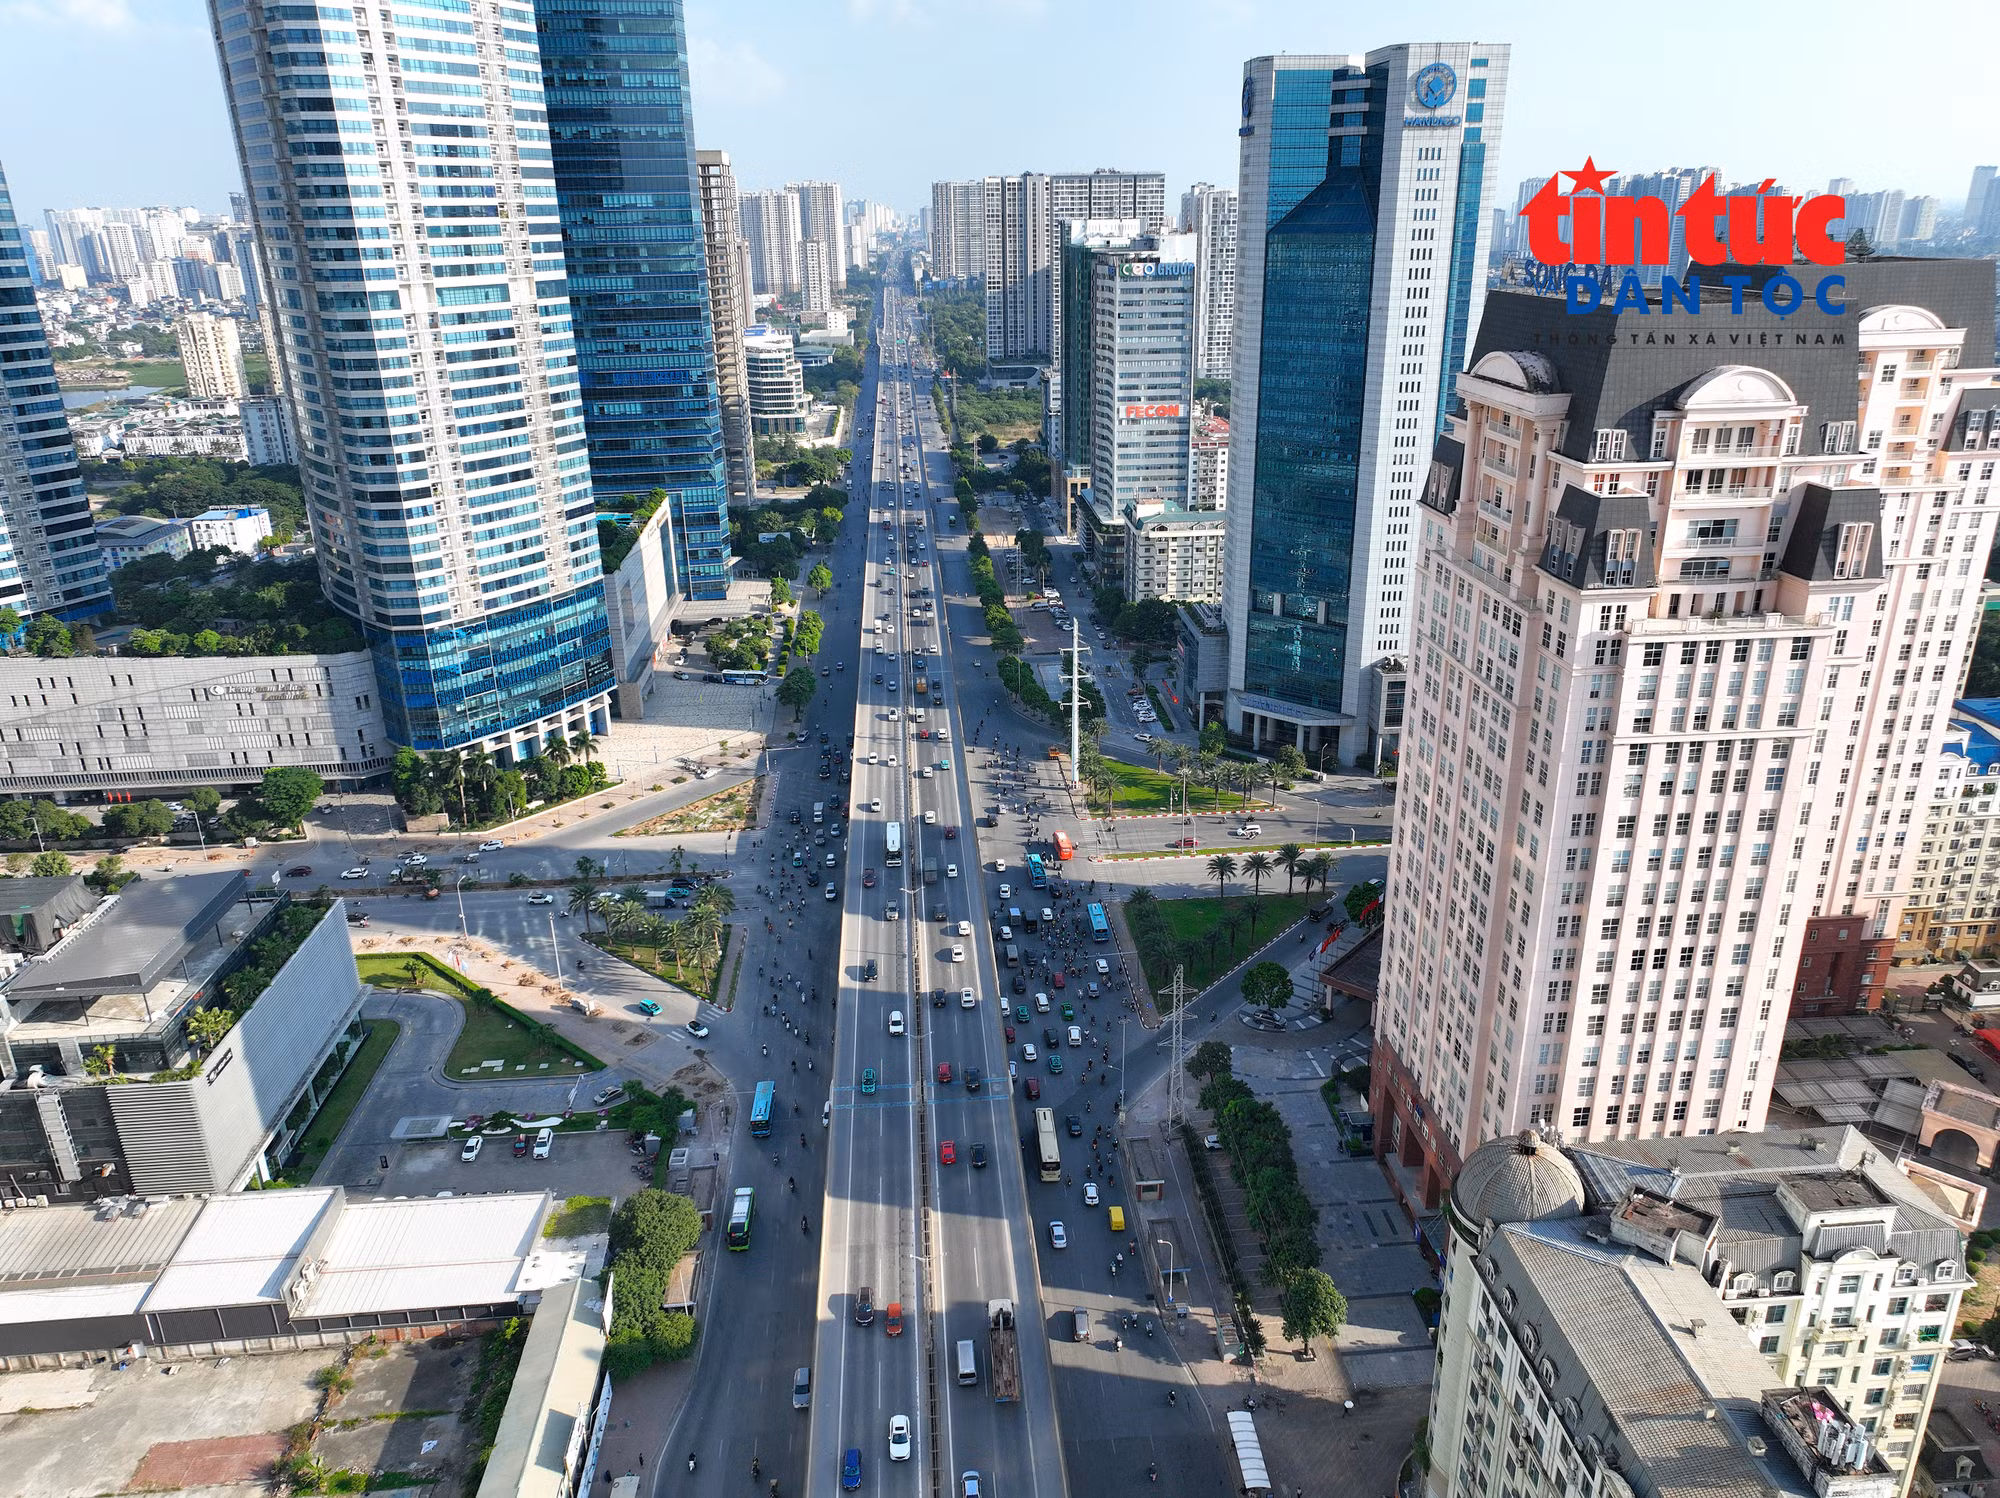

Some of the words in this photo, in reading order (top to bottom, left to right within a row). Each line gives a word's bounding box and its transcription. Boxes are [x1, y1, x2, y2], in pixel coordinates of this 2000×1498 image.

[1404, 115, 1462, 127] HANDICO
[1157, 262, 1195, 276] GROUP
[1125, 404, 1180, 418] FECON
